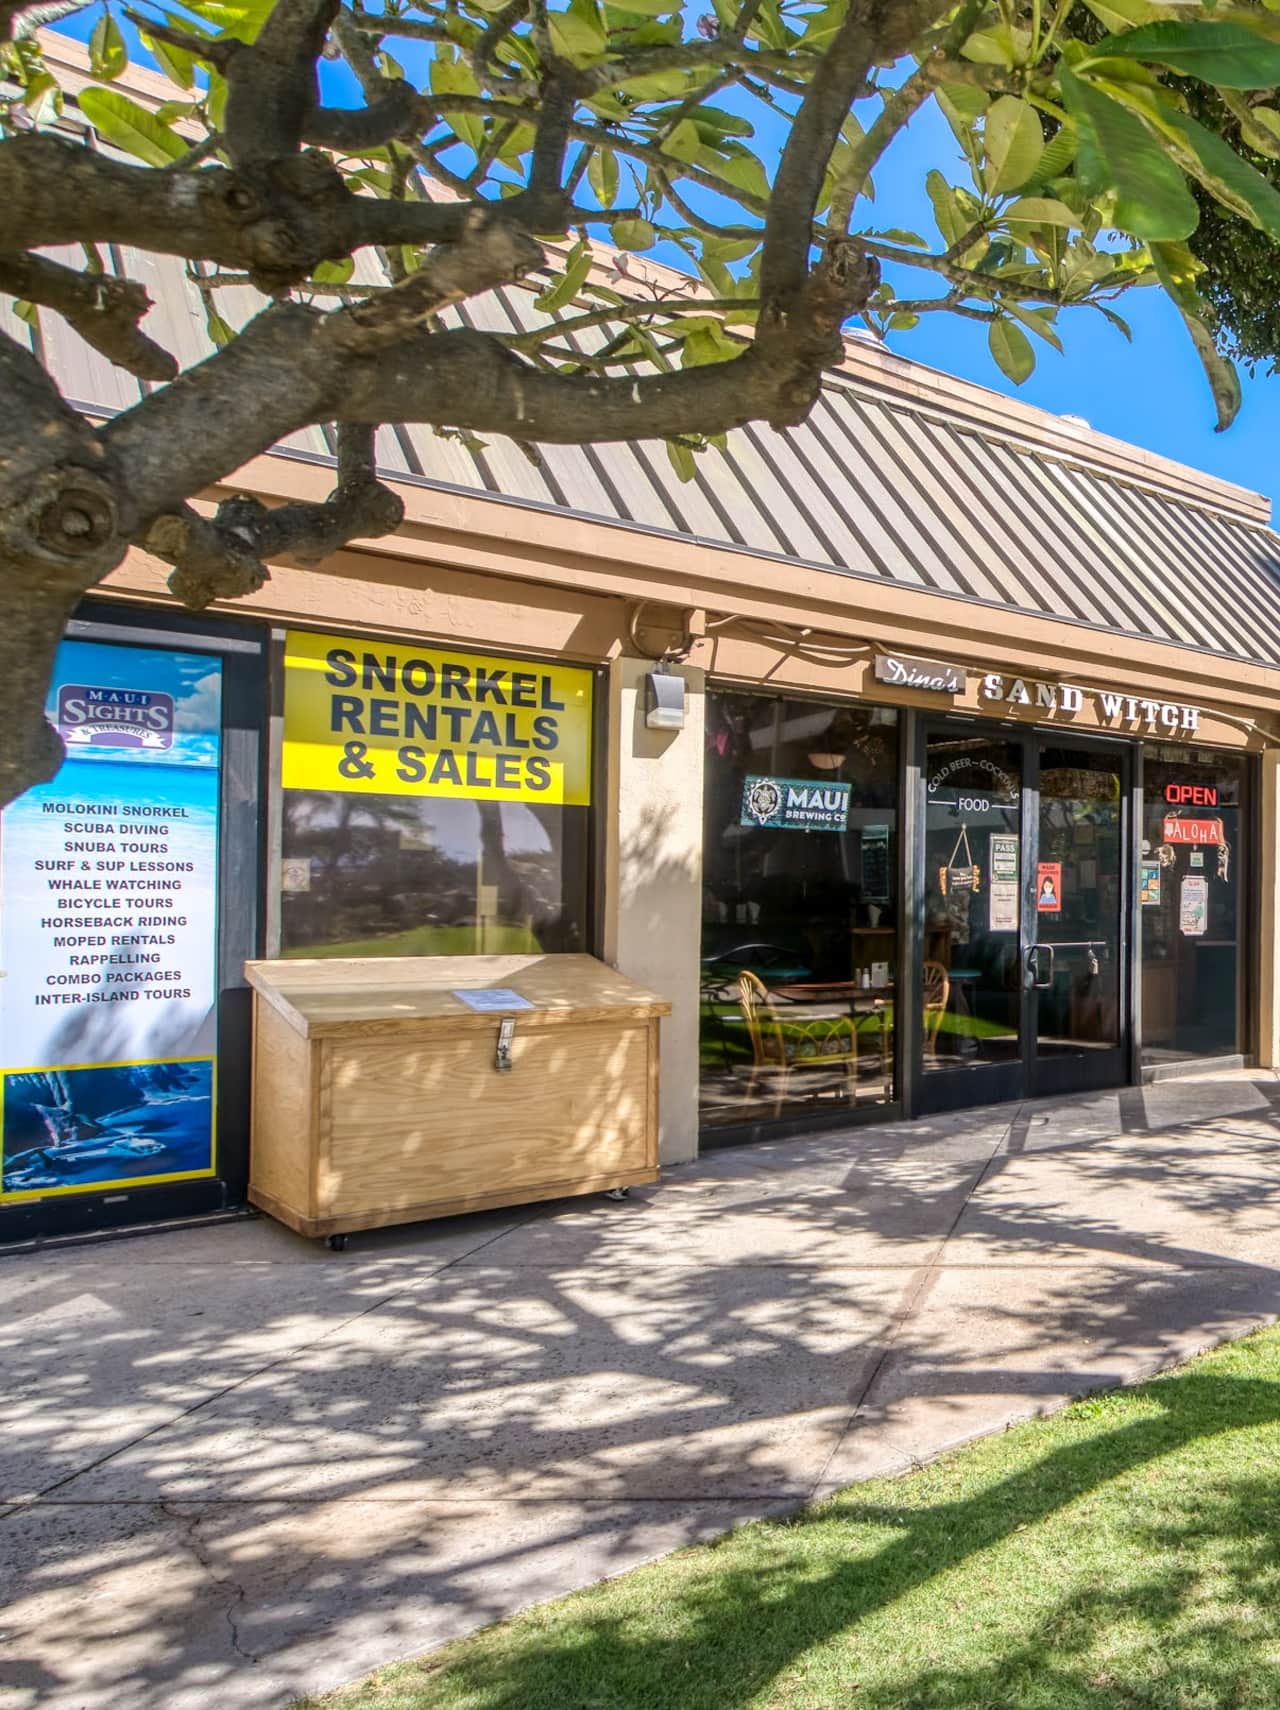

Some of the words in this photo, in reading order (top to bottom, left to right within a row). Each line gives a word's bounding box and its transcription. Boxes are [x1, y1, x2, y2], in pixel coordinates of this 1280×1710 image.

[324, 648, 566, 711] SNORKEL
[882, 658, 959, 693] Dina's
[983, 674, 1083, 712] SAND
[1100, 693, 1201, 730] WITCH
[63, 699, 169, 730] SIGHTS
[330, 694, 560, 751] RENTALS
[93, 723, 154, 740] TREASURES
[337, 740, 377, 781] &
[396, 745, 552, 791] SALES
[927, 767, 950, 793] COLD
[949, 757, 972, 772] BEER
[786, 787, 849, 812] MAUI
[1165, 783, 1217, 806] OPEN
[42, 802, 118, 816] MOLOKINI
[122, 805, 190, 818] SNORKEL
[958, 797, 990, 812] FOOD
[785, 810, 832, 821] BREWING
[63, 822, 115, 834] SCUBA
[119, 824, 169, 836] DIVING
[64, 841, 116, 853] SNUBA
[120, 843, 169, 854] TOURS
[34, 860, 76, 871] SURF
[80, 860, 91, 871] &
[96, 861, 125, 872] SUP
[129, 861, 195, 872] LESSONS
[48, 879, 102, 890] WHALE
[105, 879, 182, 890] WATCHING
[57, 898, 121, 909] BICYCLE
[124, 898, 174, 908] TOURS
[41, 916, 133, 928] HORSEBACK
[137, 916, 188, 927] RIDING
[53, 935, 107, 947] MOPED
[111, 934, 176, 946] RENTALS
[69, 953, 161, 966] RAPPELLING
[46, 973, 102, 986] COMBO
[105, 970, 182, 983] PACKAGES
[35, 990, 140, 1005] INTER-ISLAND
[143, 988, 192, 1000] TOURS
